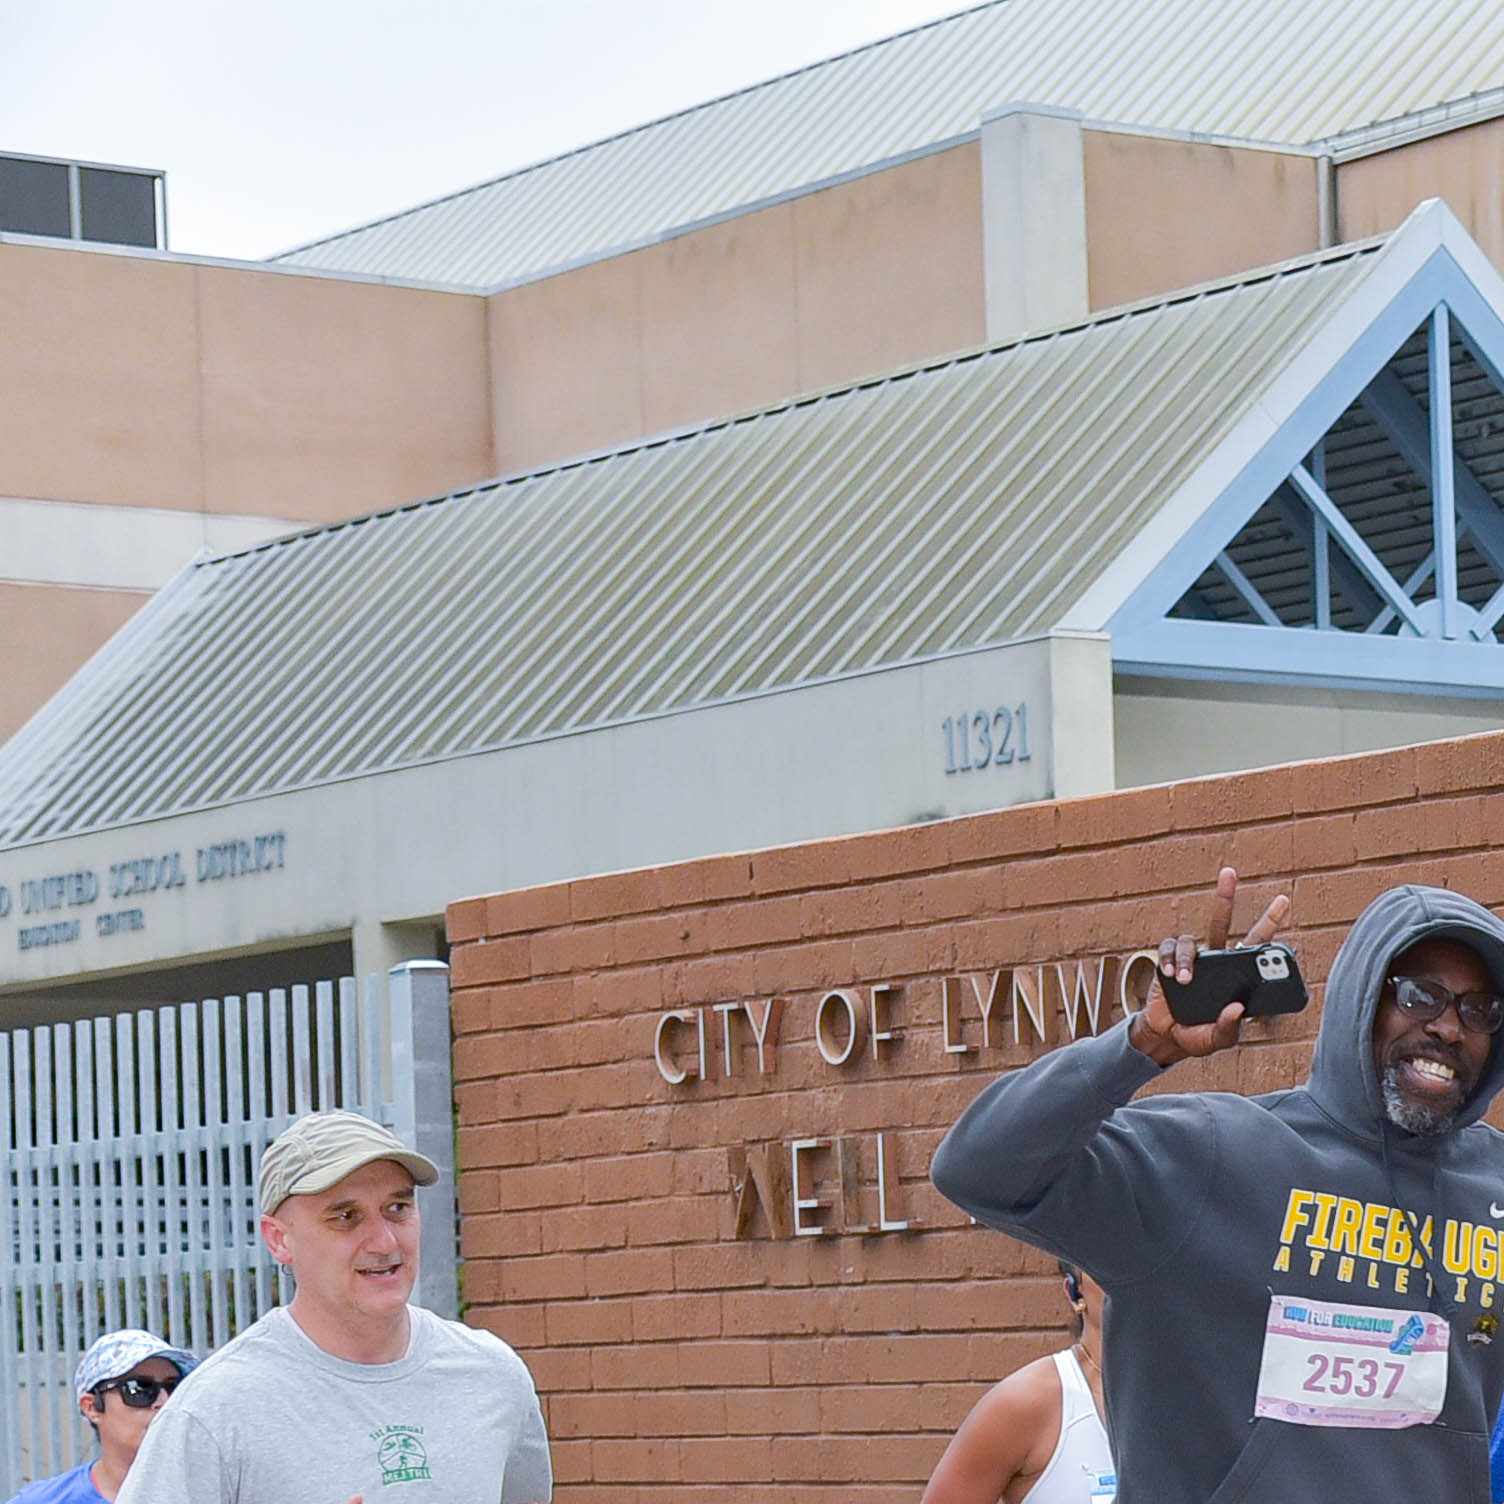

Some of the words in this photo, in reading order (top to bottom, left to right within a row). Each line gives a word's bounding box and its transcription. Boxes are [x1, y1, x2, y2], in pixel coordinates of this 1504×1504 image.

[941, 701, 1032, 774] 11321
[20, 870, 99, 914] UNIFIED
[110, 850, 187, 898] SCHOOL
[197, 830, 286, 882] DISTRICT
[654, 999, 784, 1085] CITY
[815, 983, 903, 1067] OF
[942, 950, 1160, 1054] LYNWO
[1309, 1309, 1331, 1326] FOR
[1332, 1313, 1395, 1334] EDUCATION
[1302, 1353, 1405, 1399] 2537
